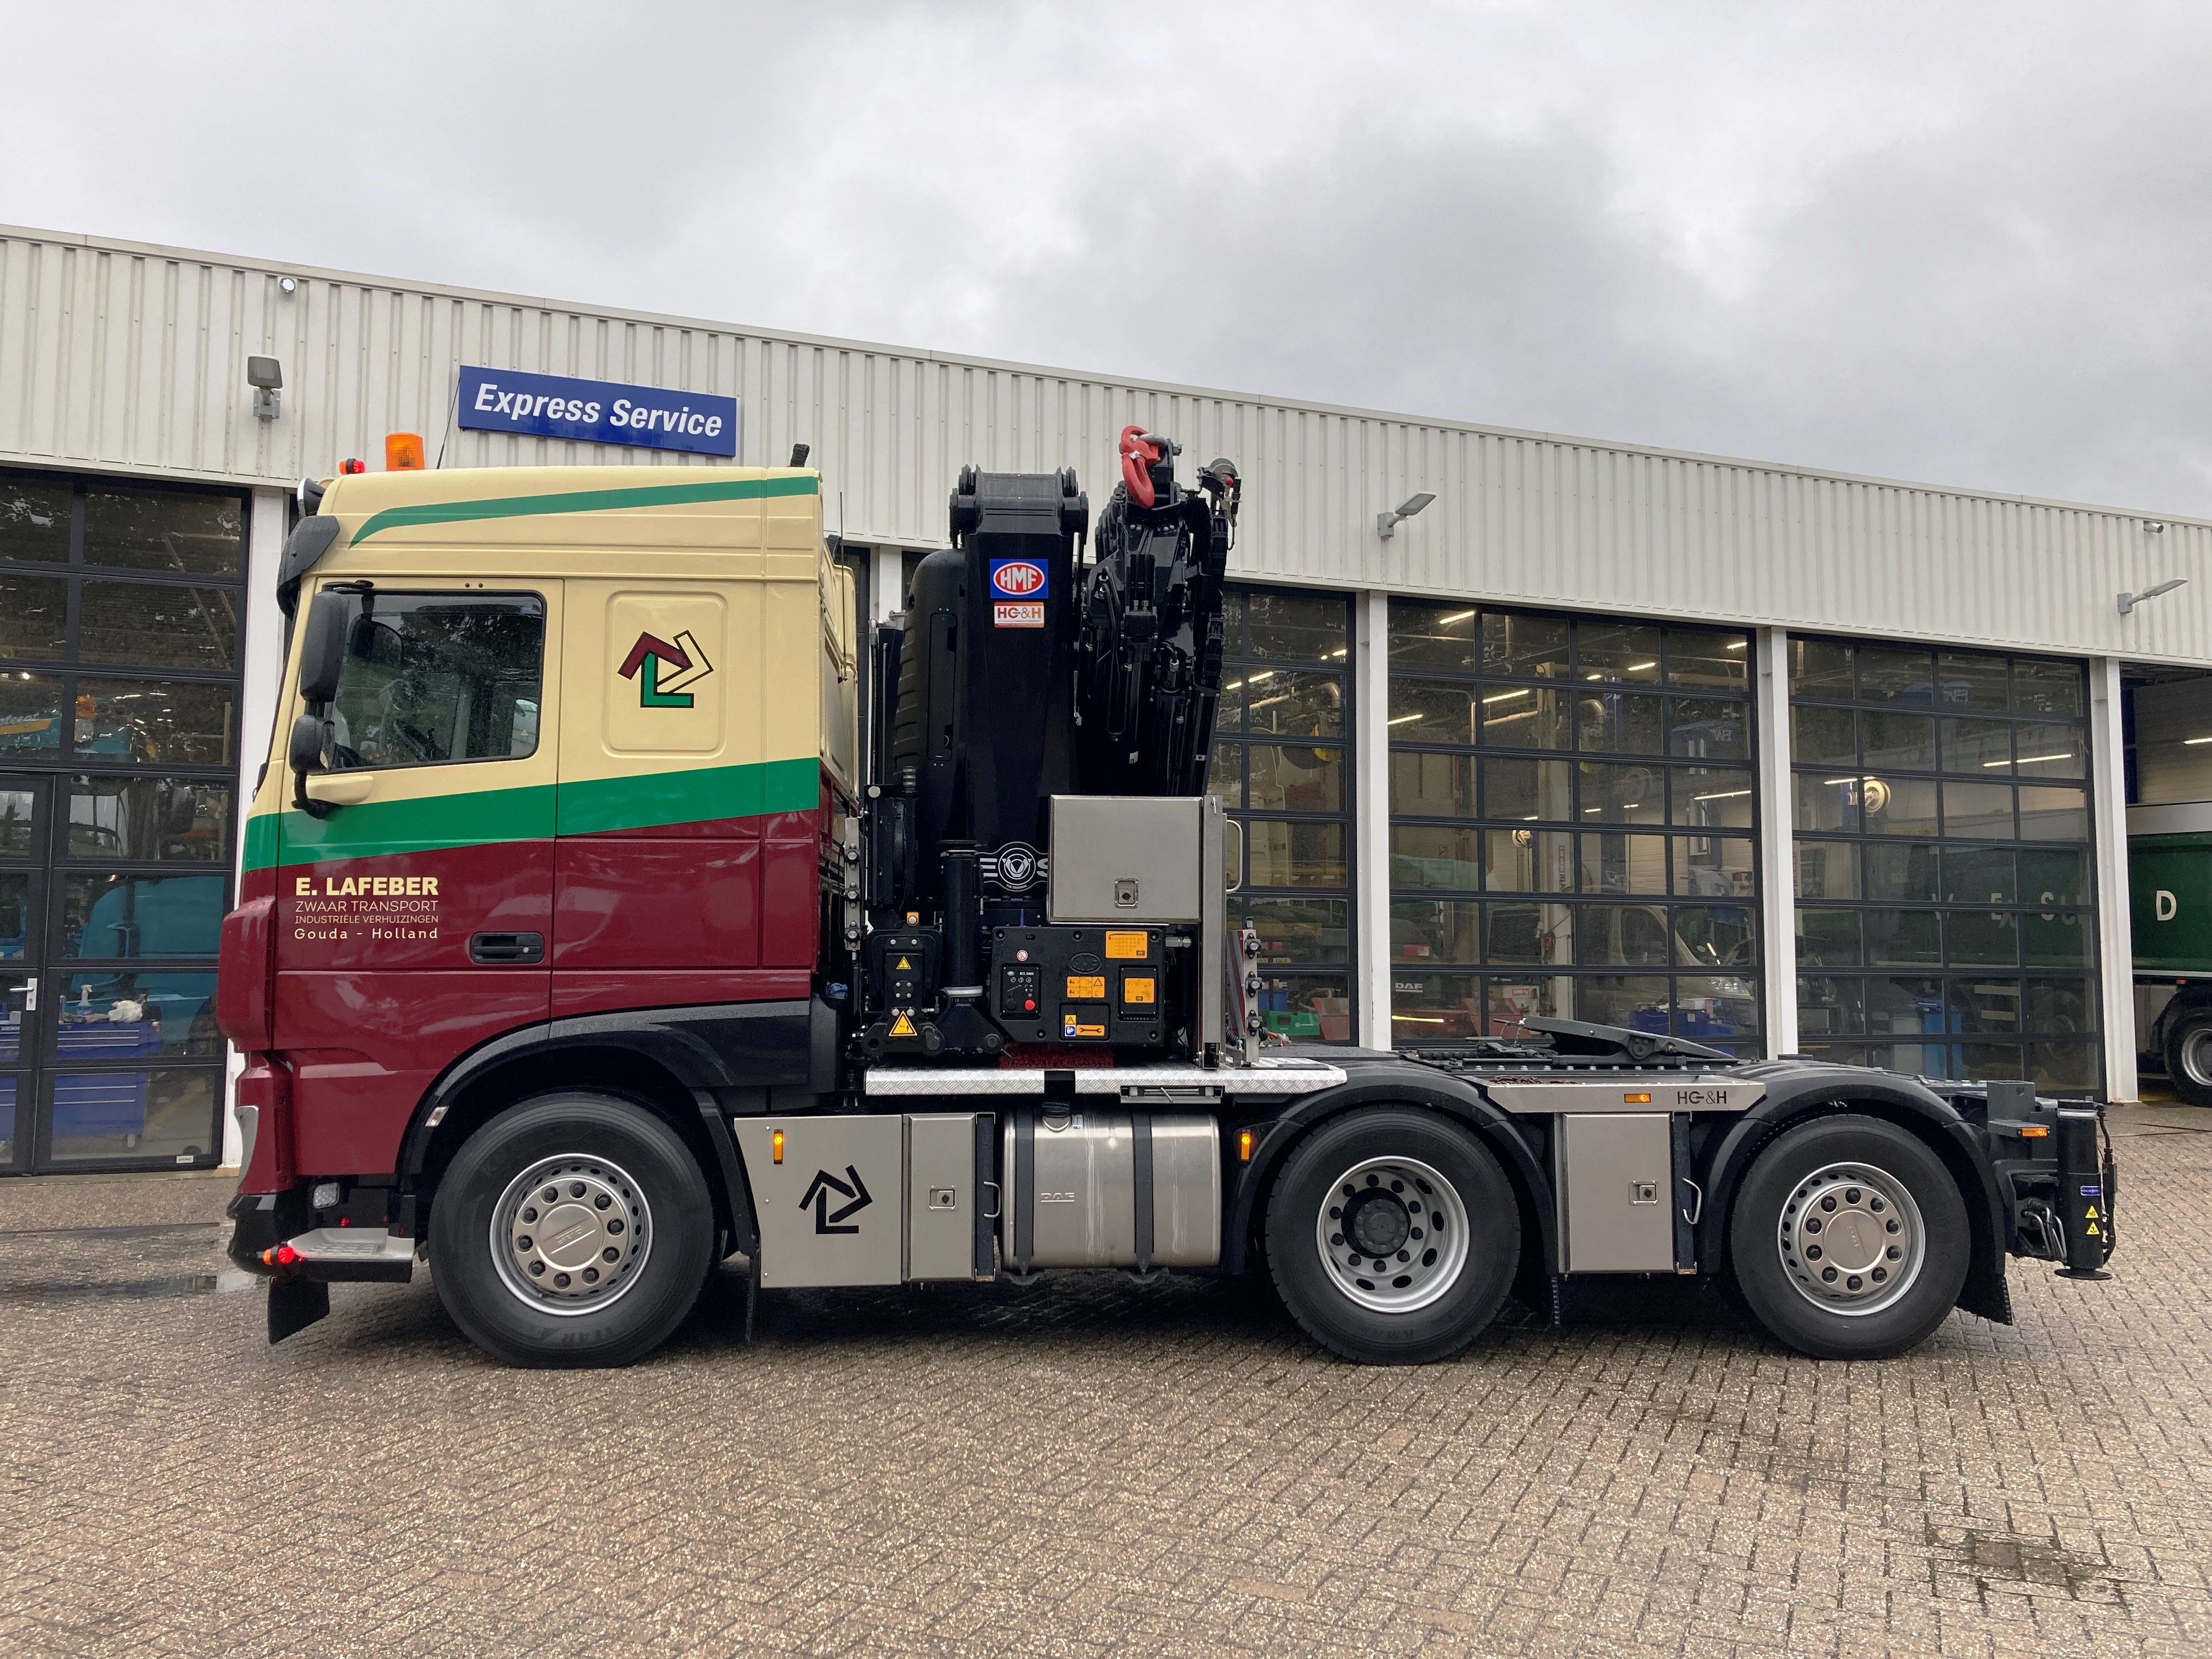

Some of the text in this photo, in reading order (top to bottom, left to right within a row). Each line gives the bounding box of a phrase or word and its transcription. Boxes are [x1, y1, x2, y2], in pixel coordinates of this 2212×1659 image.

[474, 383, 723, 437] Express Service
[1000, 567, 1037, 590] HMF
[296, 877, 439, 896] E. LAFEBER
[295, 900, 439, 912] ZWAAR TRANSPORT
[295, 914, 438, 924] INDUSTRIËLE VERHUIZINGEN
[294, 928, 348, 939] Gouda
[372, 927, 438, 939] Holland
